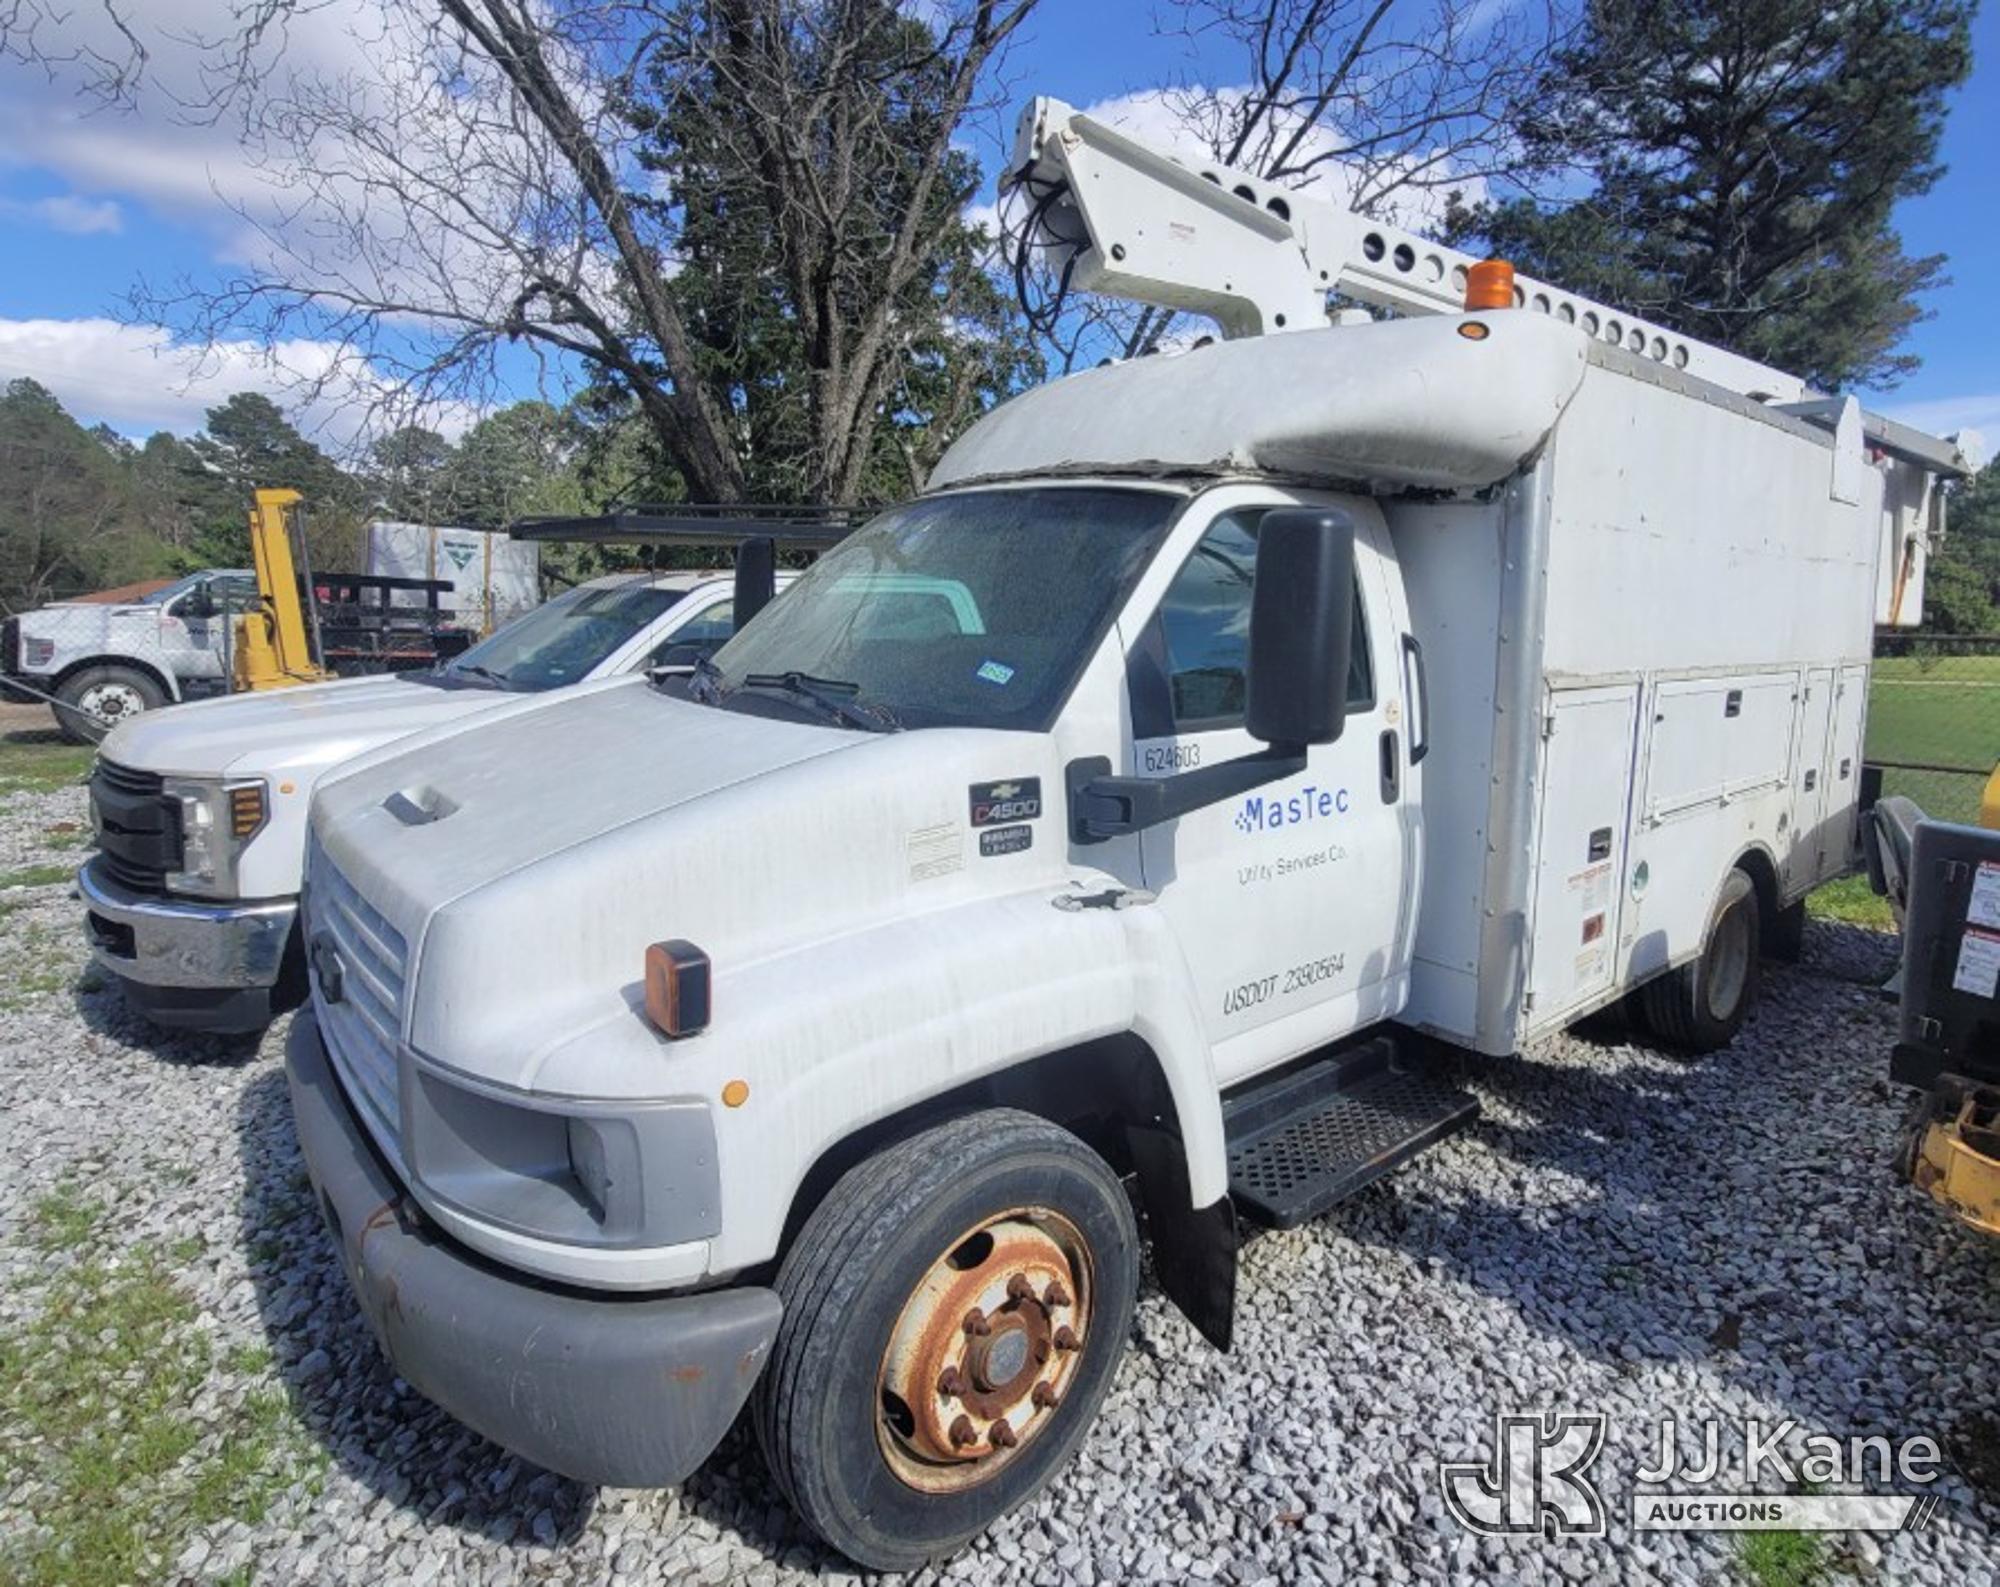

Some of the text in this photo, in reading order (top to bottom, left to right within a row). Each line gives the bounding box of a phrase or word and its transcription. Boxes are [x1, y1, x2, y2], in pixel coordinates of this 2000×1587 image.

[1144, 743, 1201, 772] 624603
[974, 800, 1038, 823] C4500
[1243, 785, 1350, 833] MasTec
[1237, 864, 1273, 886] Utlty
[1276, 850, 1327, 875] Services
[1223, 974, 1279, 1015] USDOT
